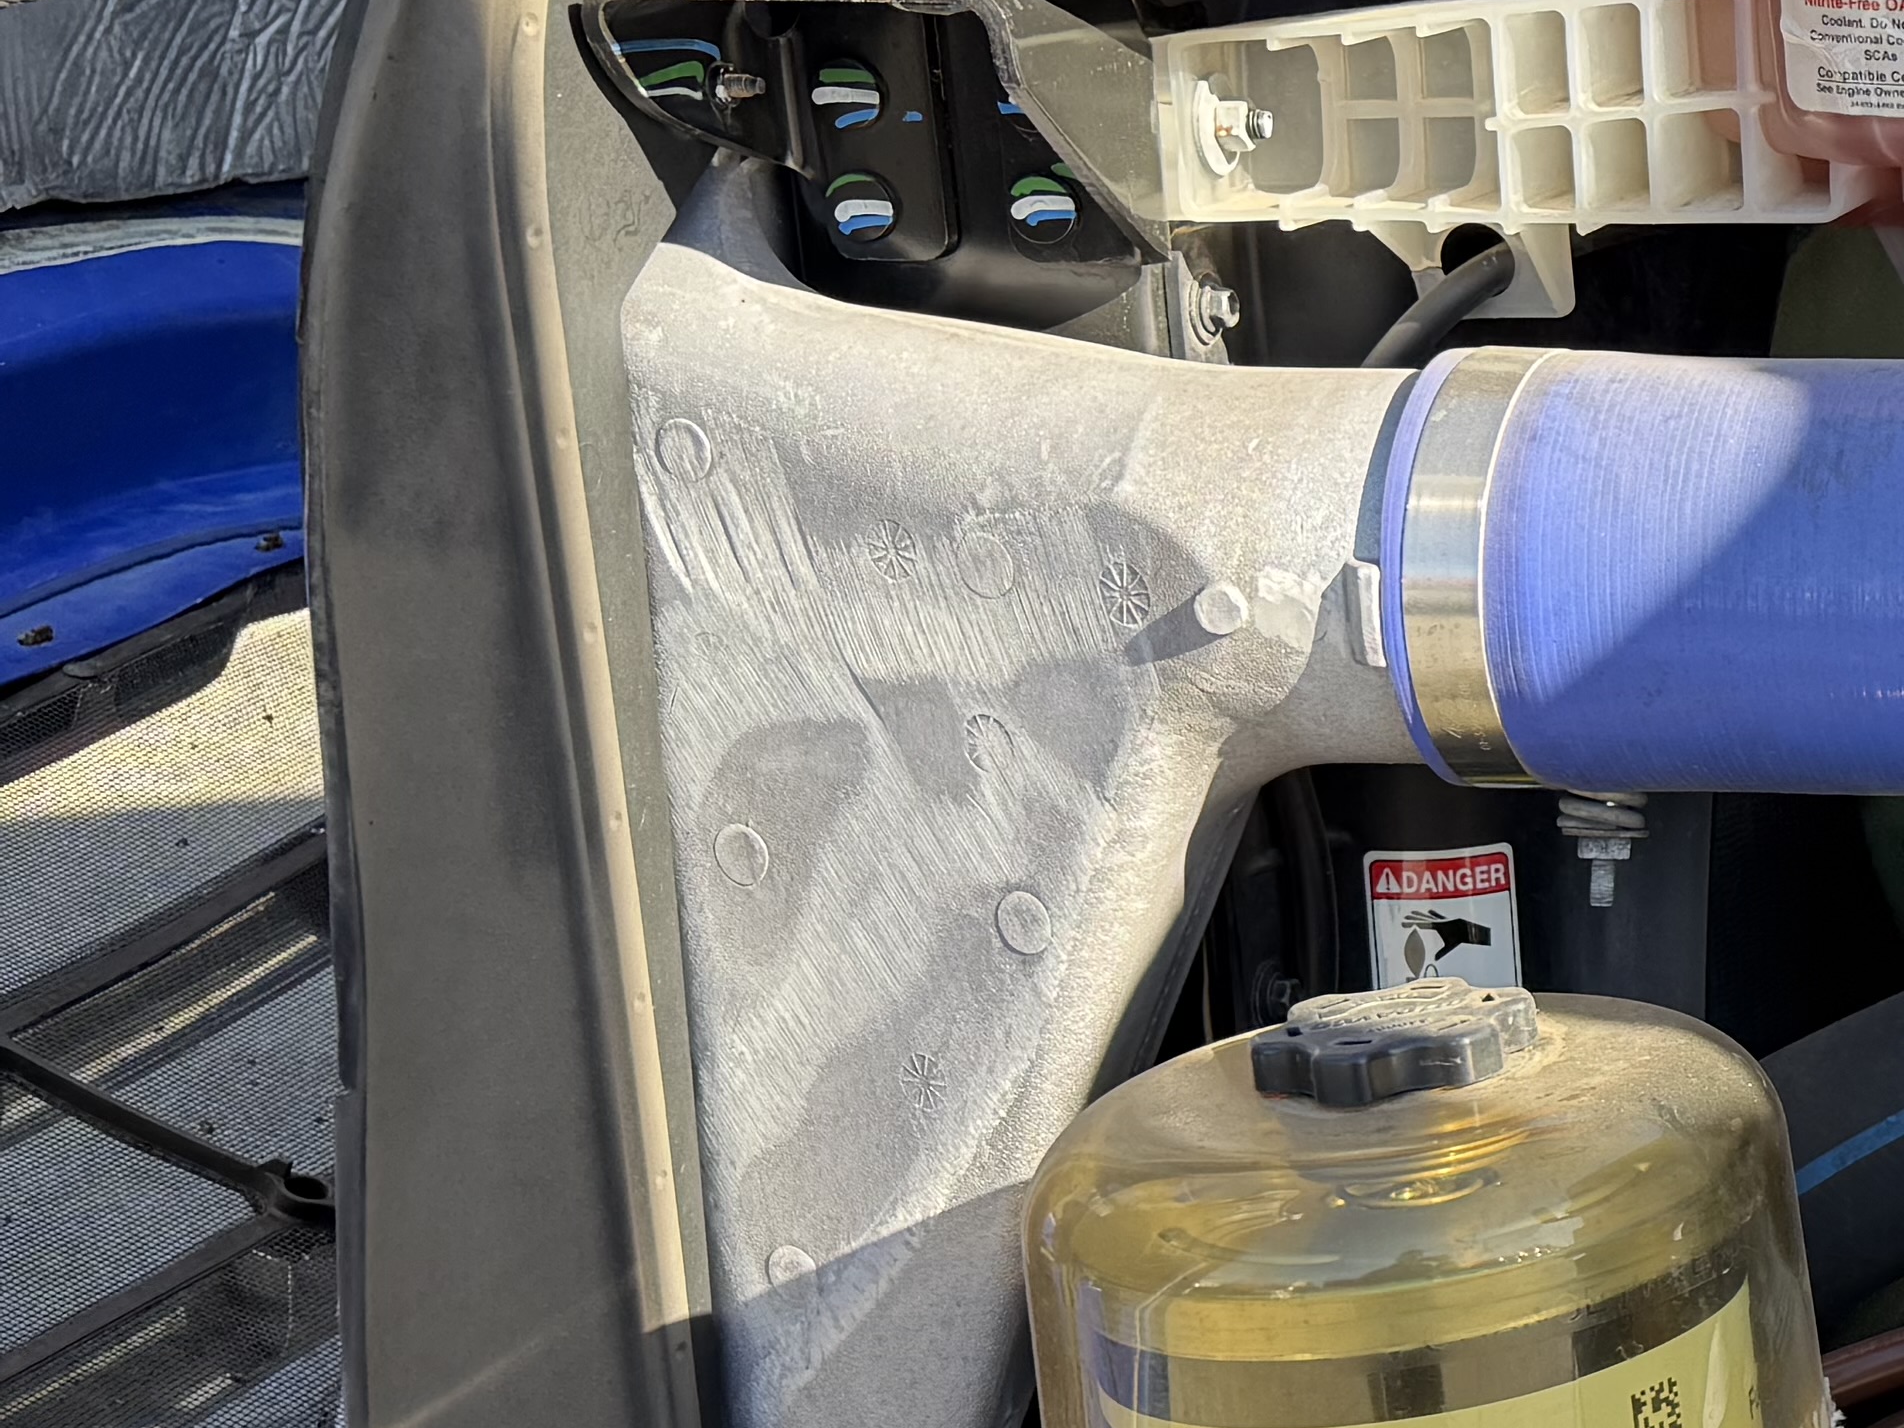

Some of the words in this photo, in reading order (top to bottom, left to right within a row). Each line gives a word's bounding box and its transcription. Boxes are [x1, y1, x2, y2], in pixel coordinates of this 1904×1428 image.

[1870, 18, 1888, 29] Do
[1864, 50, 1898, 61] SCAs
[1817, 83, 1832, 93] See
[1402, 863, 1506, 893] DANGER
